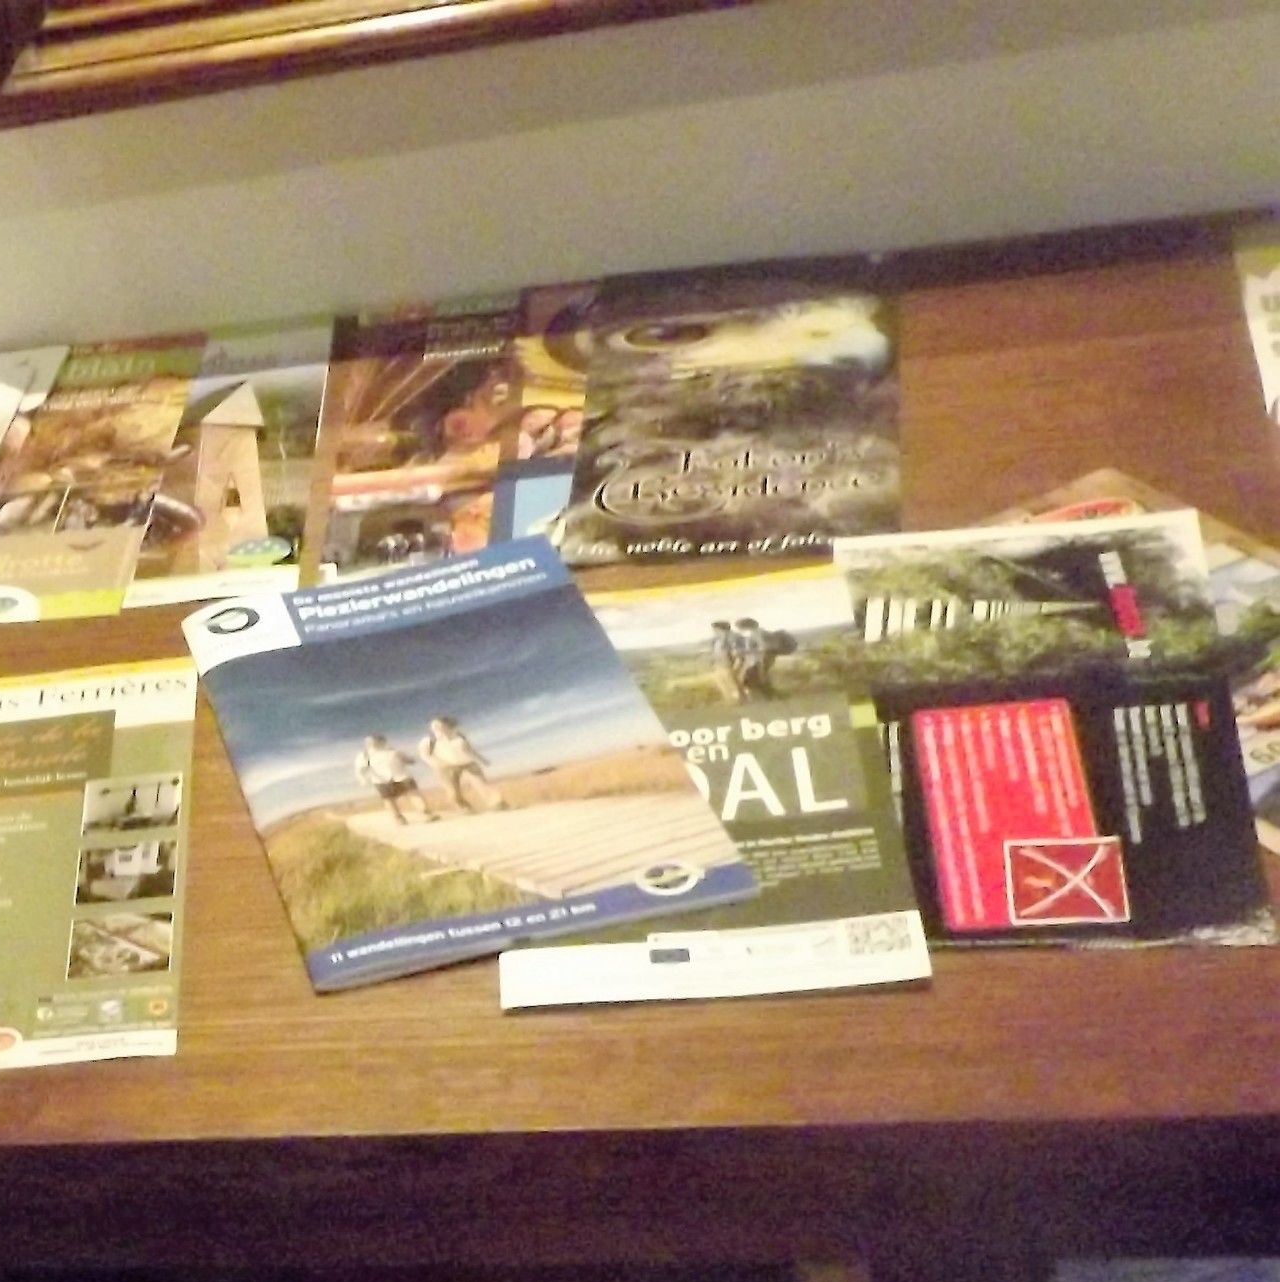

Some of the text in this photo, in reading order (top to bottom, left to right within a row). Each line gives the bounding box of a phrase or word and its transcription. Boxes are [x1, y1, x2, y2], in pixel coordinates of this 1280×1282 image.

[299, 557, 537, 621] Plezierwandelingen
[741, 713, 832, 740] berg
[687, 744, 730, 764] en
[346, 930, 445, 959] wandelingen
[448, 920, 502, 938] tussen
